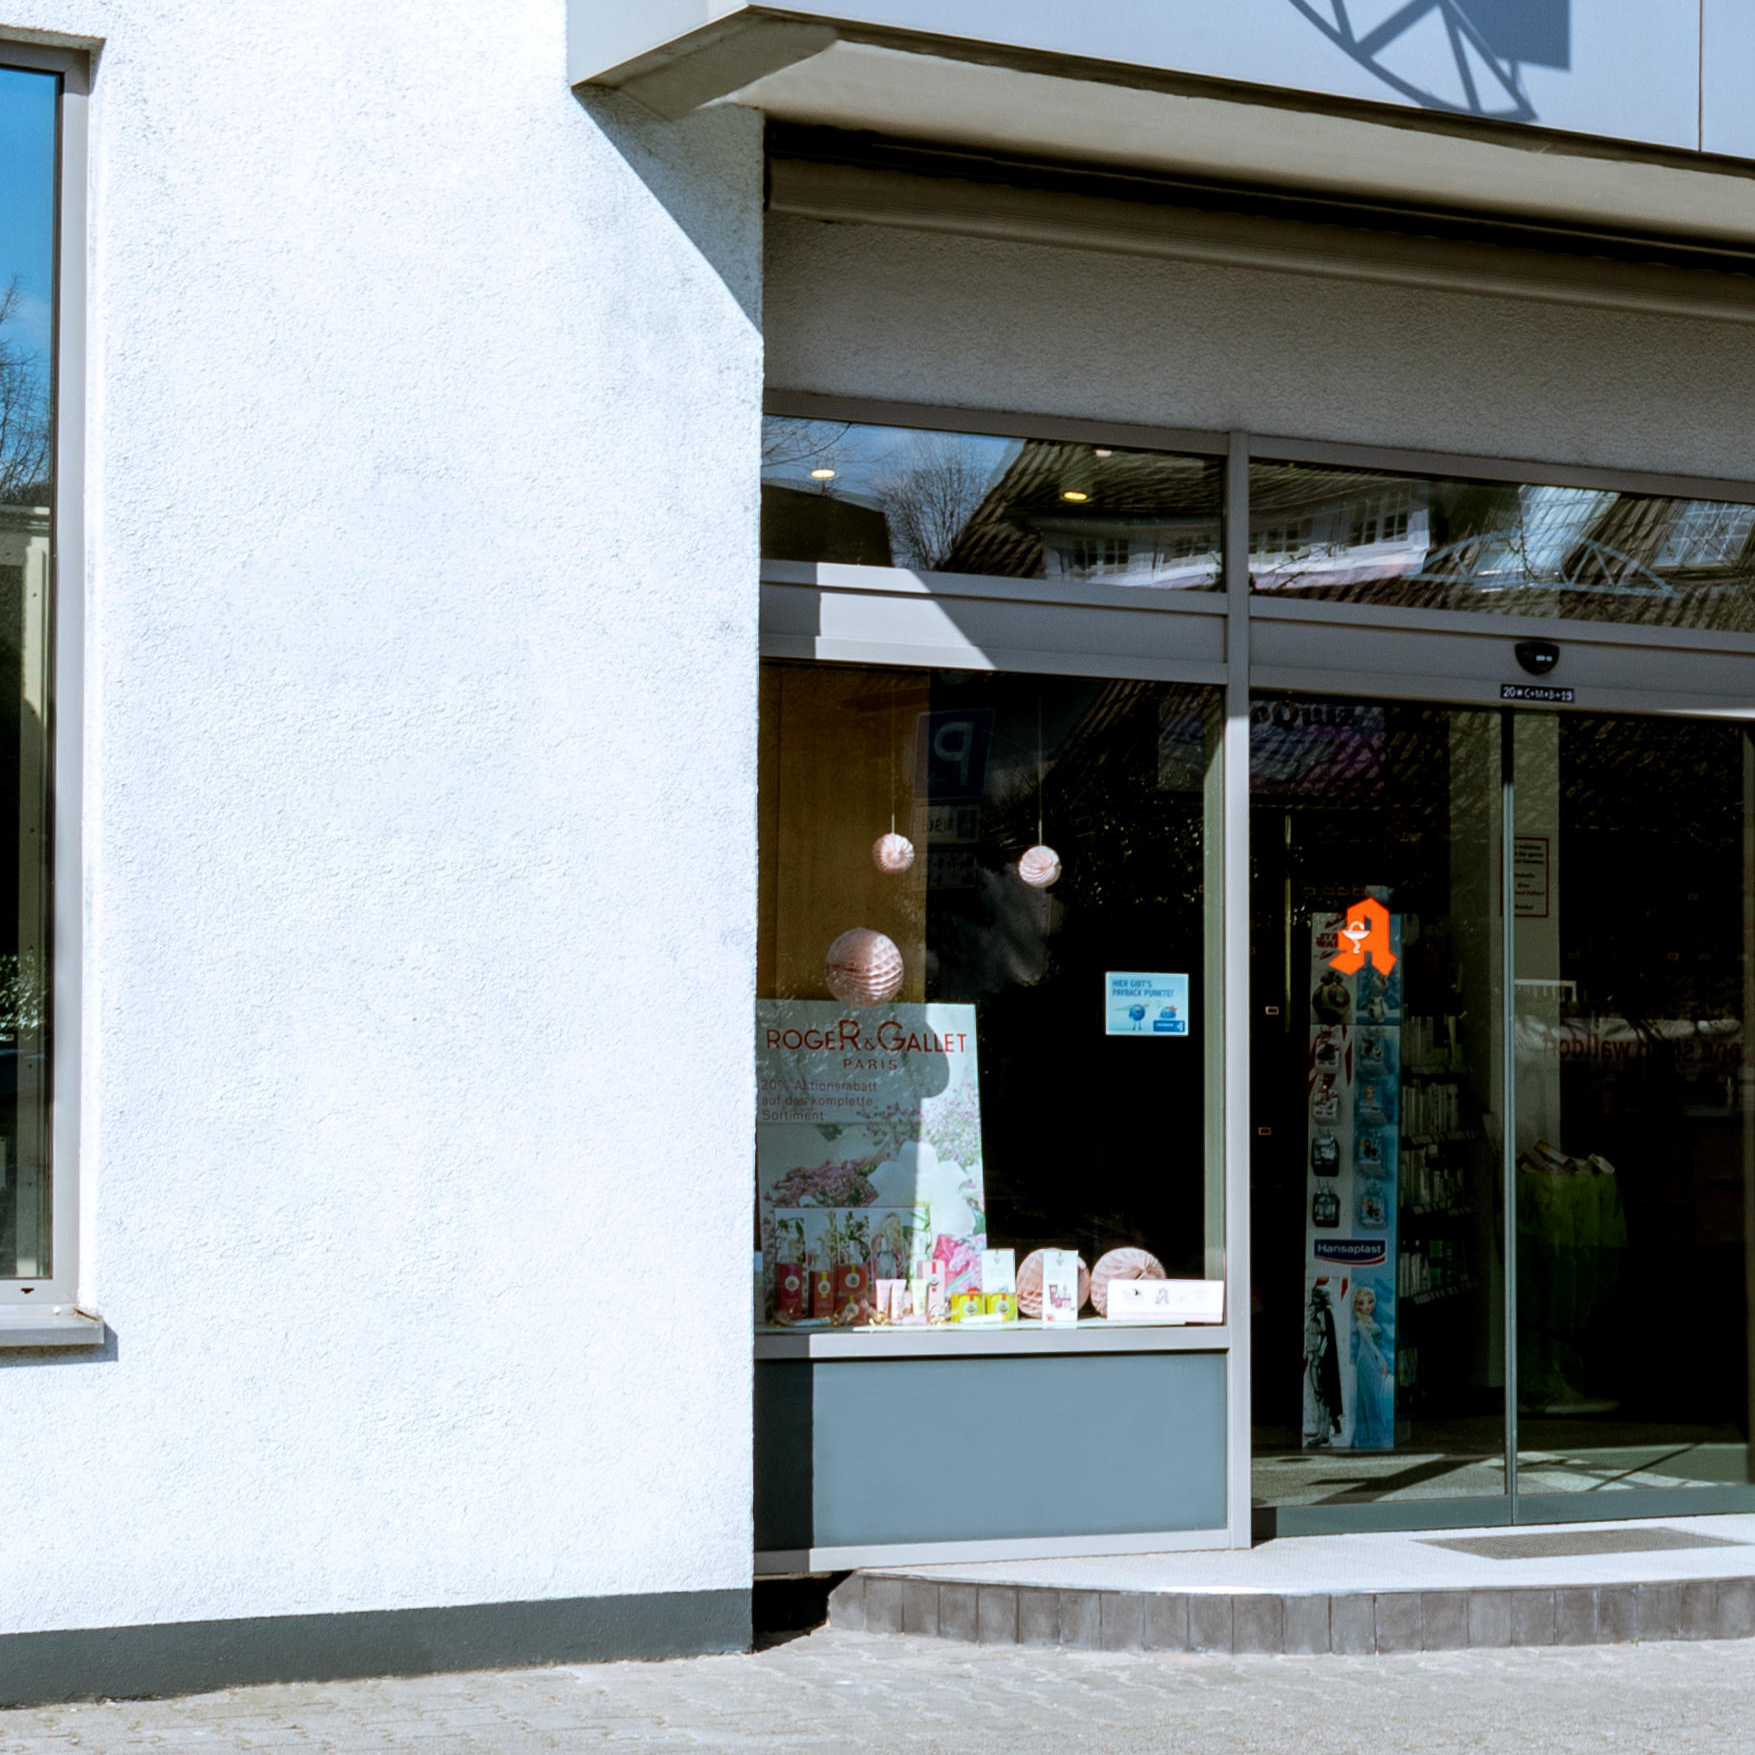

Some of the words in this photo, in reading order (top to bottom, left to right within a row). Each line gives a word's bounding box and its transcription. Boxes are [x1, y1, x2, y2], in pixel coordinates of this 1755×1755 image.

[877, 1021, 968, 1052] GALLET
[843, 1059, 898, 1070] PARIS
[761, 1080, 789, 1091] 20%
[761, 1096, 781, 1107] auf
[785, 1096, 807, 1107] das
[811, 1097, 874, 1108] komplette
[762, 1110, 825, 1122] Sortiment
[1317, 1244, 1382, 1255] Hansaplast
